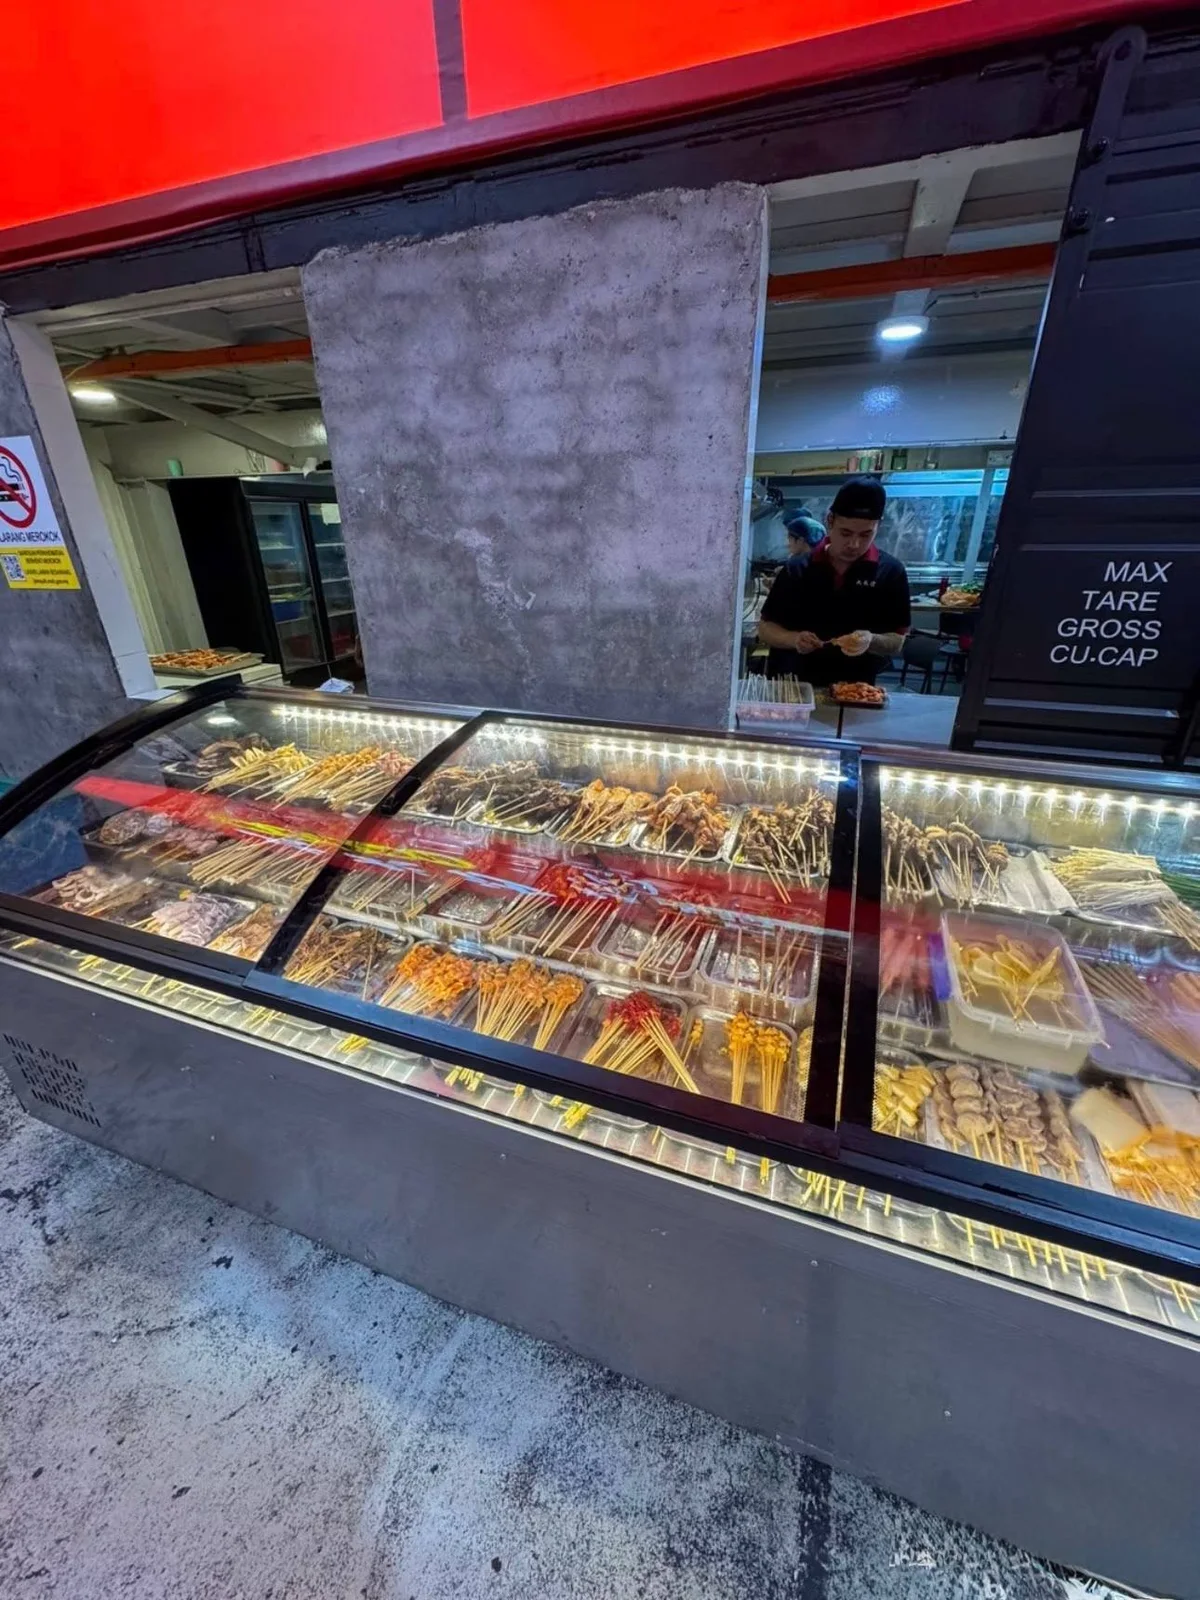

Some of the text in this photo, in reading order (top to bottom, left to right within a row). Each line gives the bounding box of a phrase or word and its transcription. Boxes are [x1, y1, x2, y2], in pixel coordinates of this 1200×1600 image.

[1103, 561, 1173, 583] MAX
[1082, 590, 1161, 612] TARE
[1057, 617, 1162, 640] GROSS
